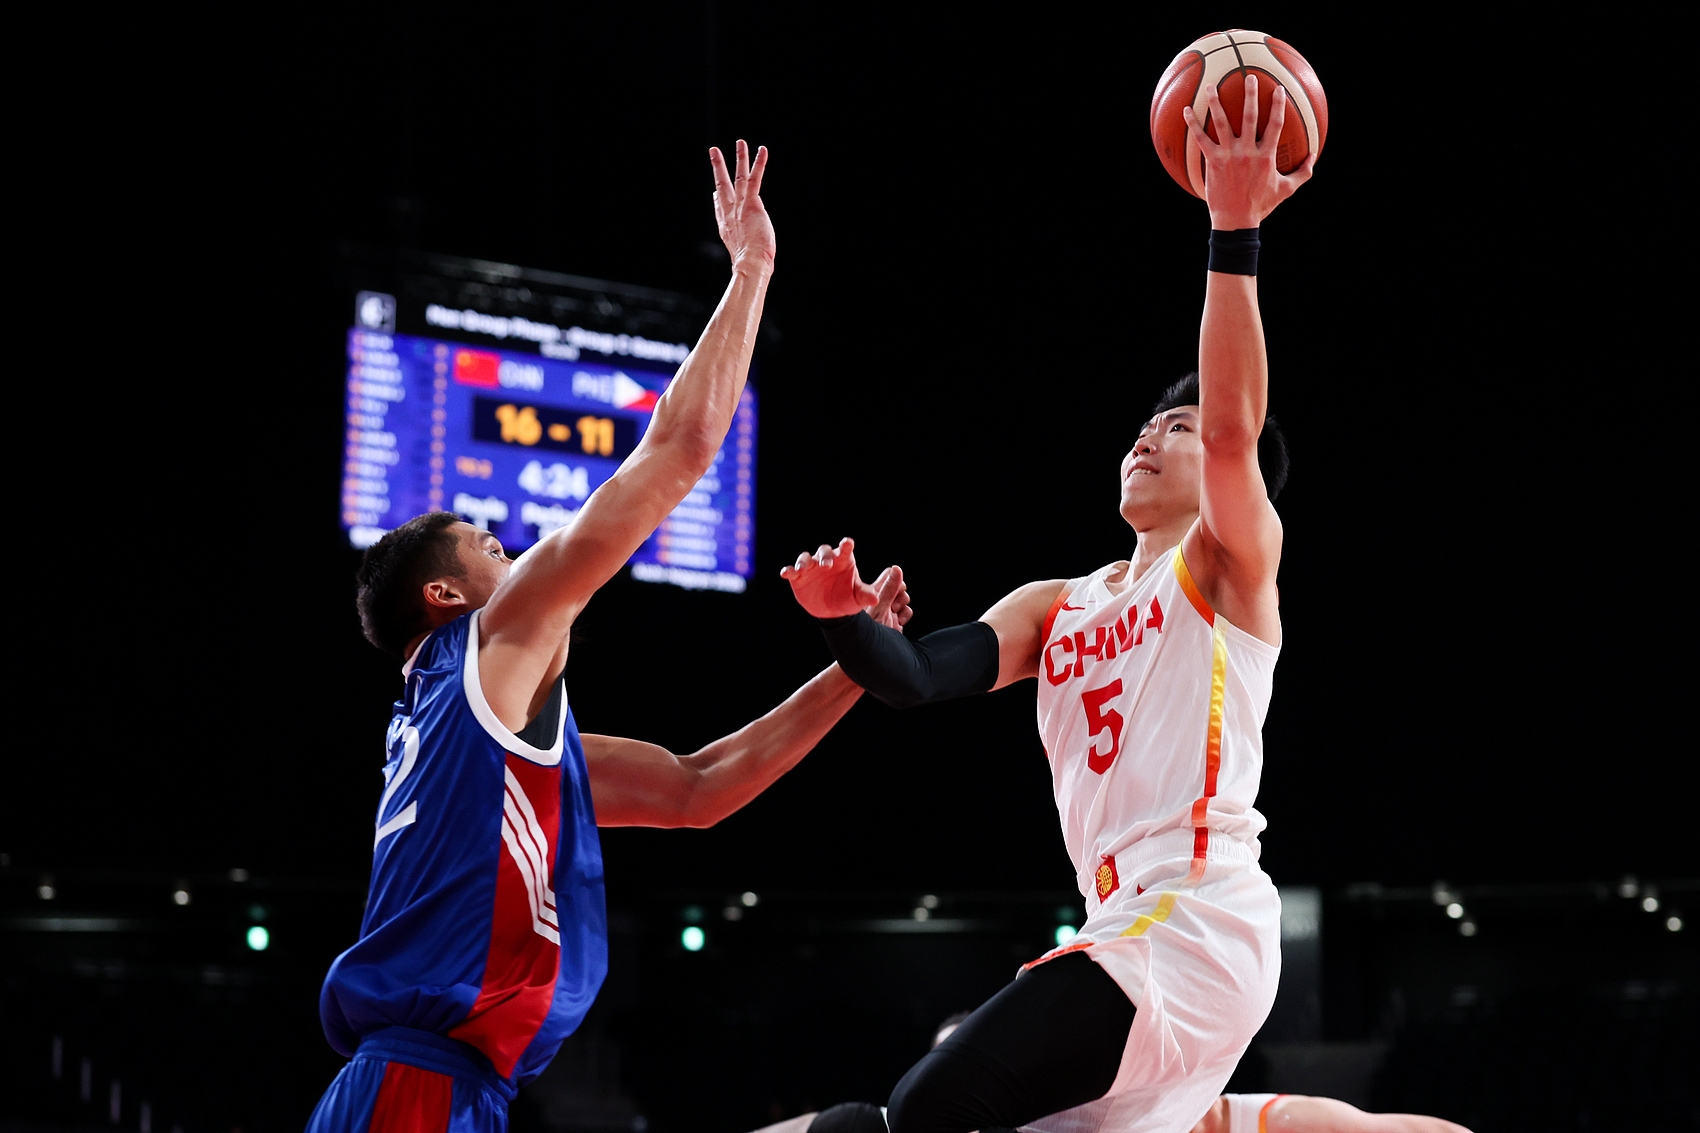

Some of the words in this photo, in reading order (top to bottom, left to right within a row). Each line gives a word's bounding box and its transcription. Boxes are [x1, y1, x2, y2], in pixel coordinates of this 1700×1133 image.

[495, 403, 543, 446] 16
[576, 415, 615, 457] 11
[1044, 595, 1164, 686] CHINA
[1081, 678, 1124, 775] 5
